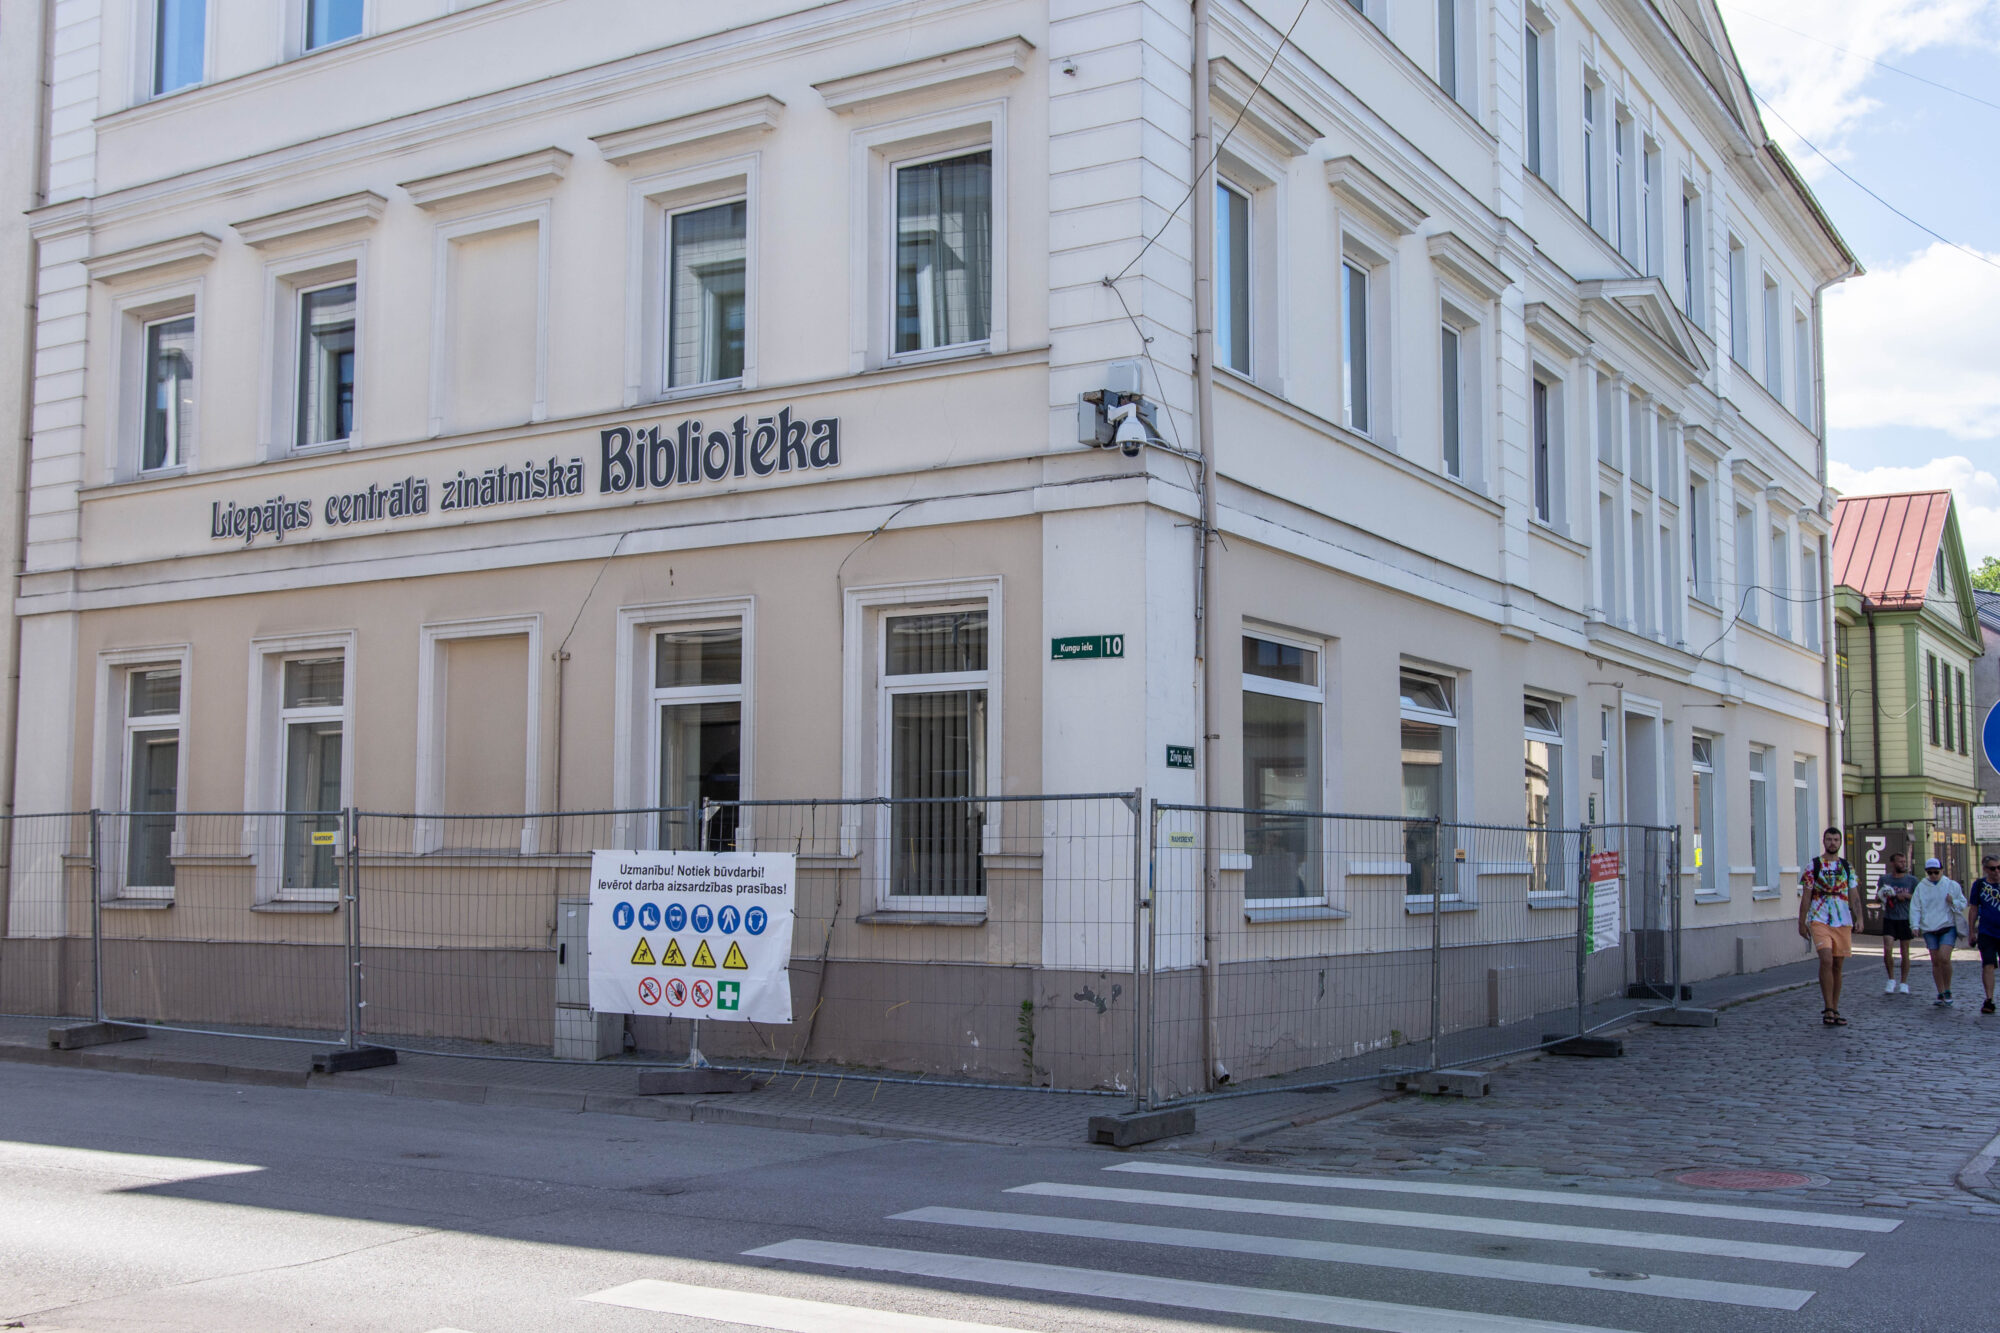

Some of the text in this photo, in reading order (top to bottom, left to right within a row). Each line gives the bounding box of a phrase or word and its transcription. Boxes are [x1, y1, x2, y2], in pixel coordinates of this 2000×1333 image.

[211, 405, 840, 543] Liepājas centrālā zinātniskā Bibliotēka
[1061, 642, 1093, 654] Kungu iela
[1106, 637, 1122, 655] 10
[620, 864, 764, 878] Uzmanību! Notiek būvdarbi!
[598, 879, 786, 896] Ievērot darba aizsardzības prasības!
